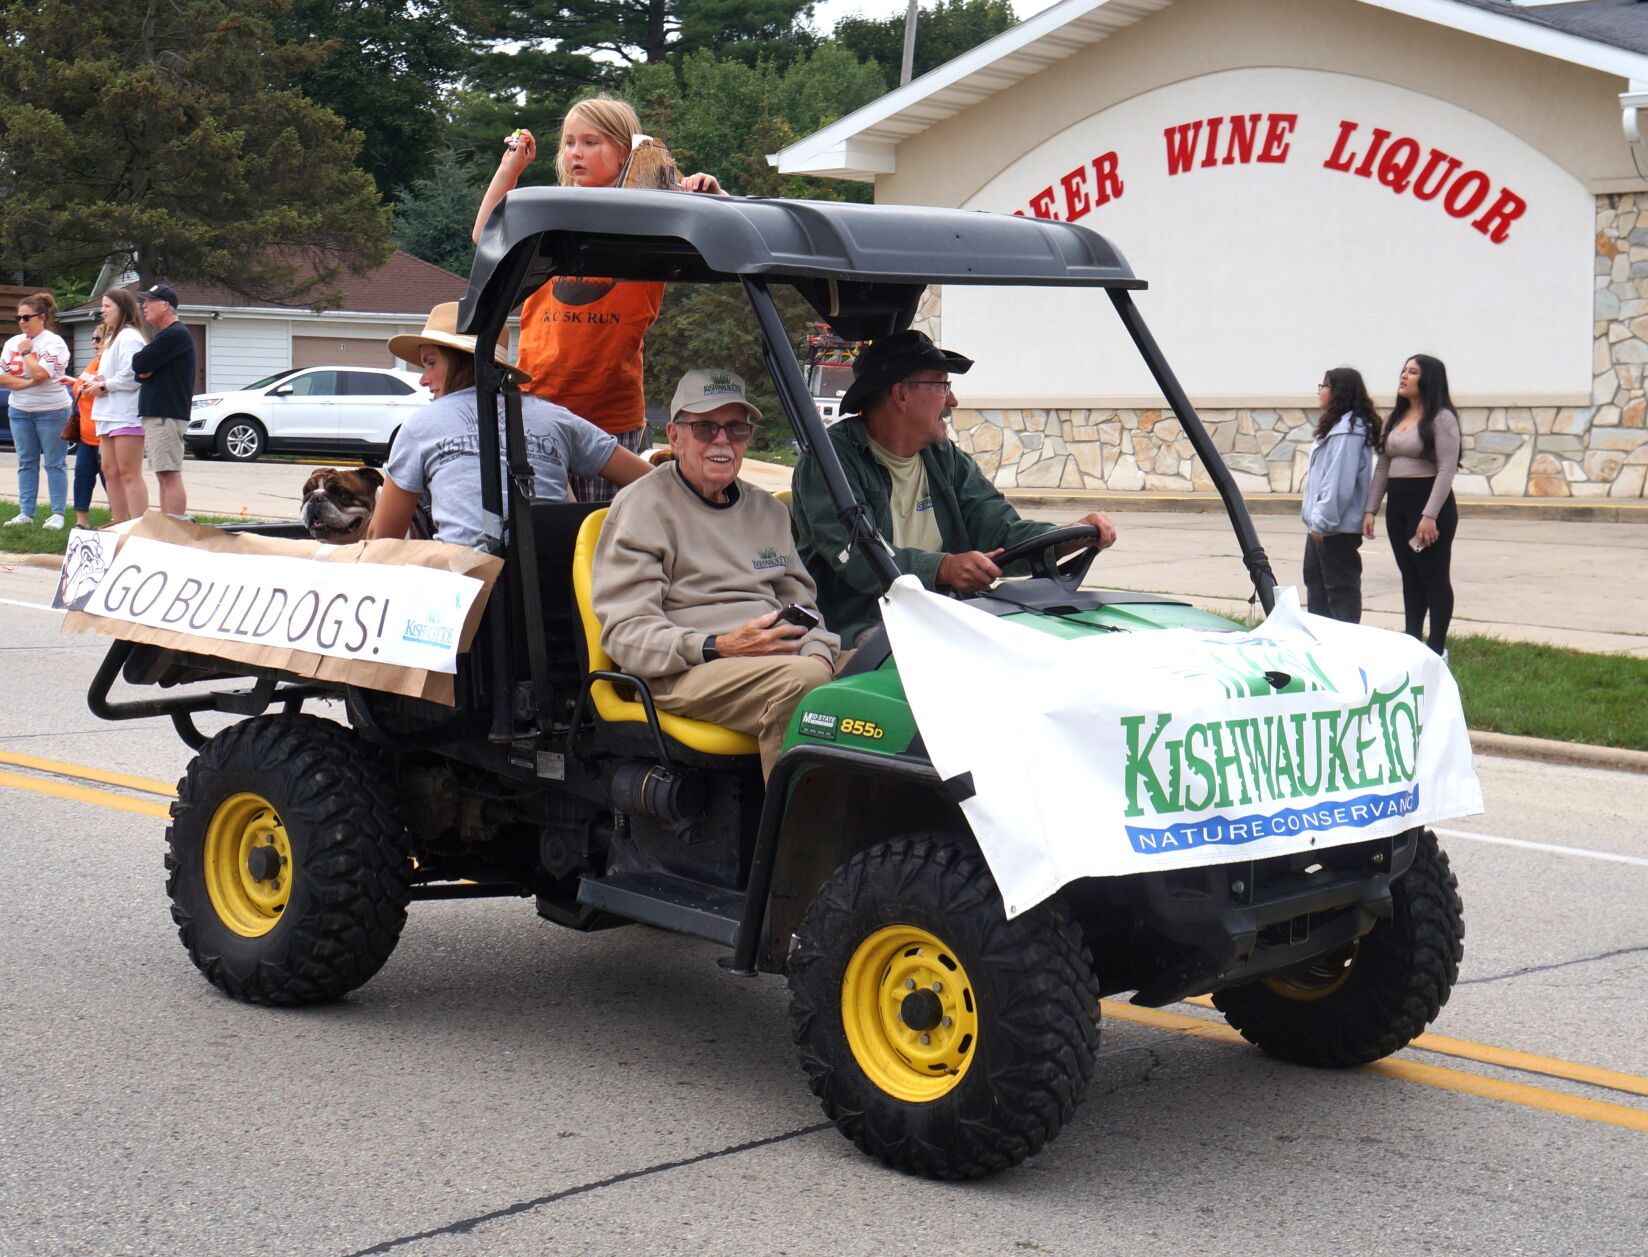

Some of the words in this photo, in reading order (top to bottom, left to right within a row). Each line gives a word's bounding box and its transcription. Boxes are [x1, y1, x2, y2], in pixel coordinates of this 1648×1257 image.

[1013, 150, 1125, 223] EER
[1163, 112, 1298, 176] WINE
[1323, 120, 1527, 245] LIQUOR
[563, 311, 583, 323] 5K
[587, 311, 621, 324] RUN
[104, 564, 168, 617] GO
[162, 577, 391, 655] BULLDOGS!
[840, 718, 883, 739] 855D
[1138, 822, 1264, 851] NATURE
[1271, 796, 1414, 833] CONSERVANC
